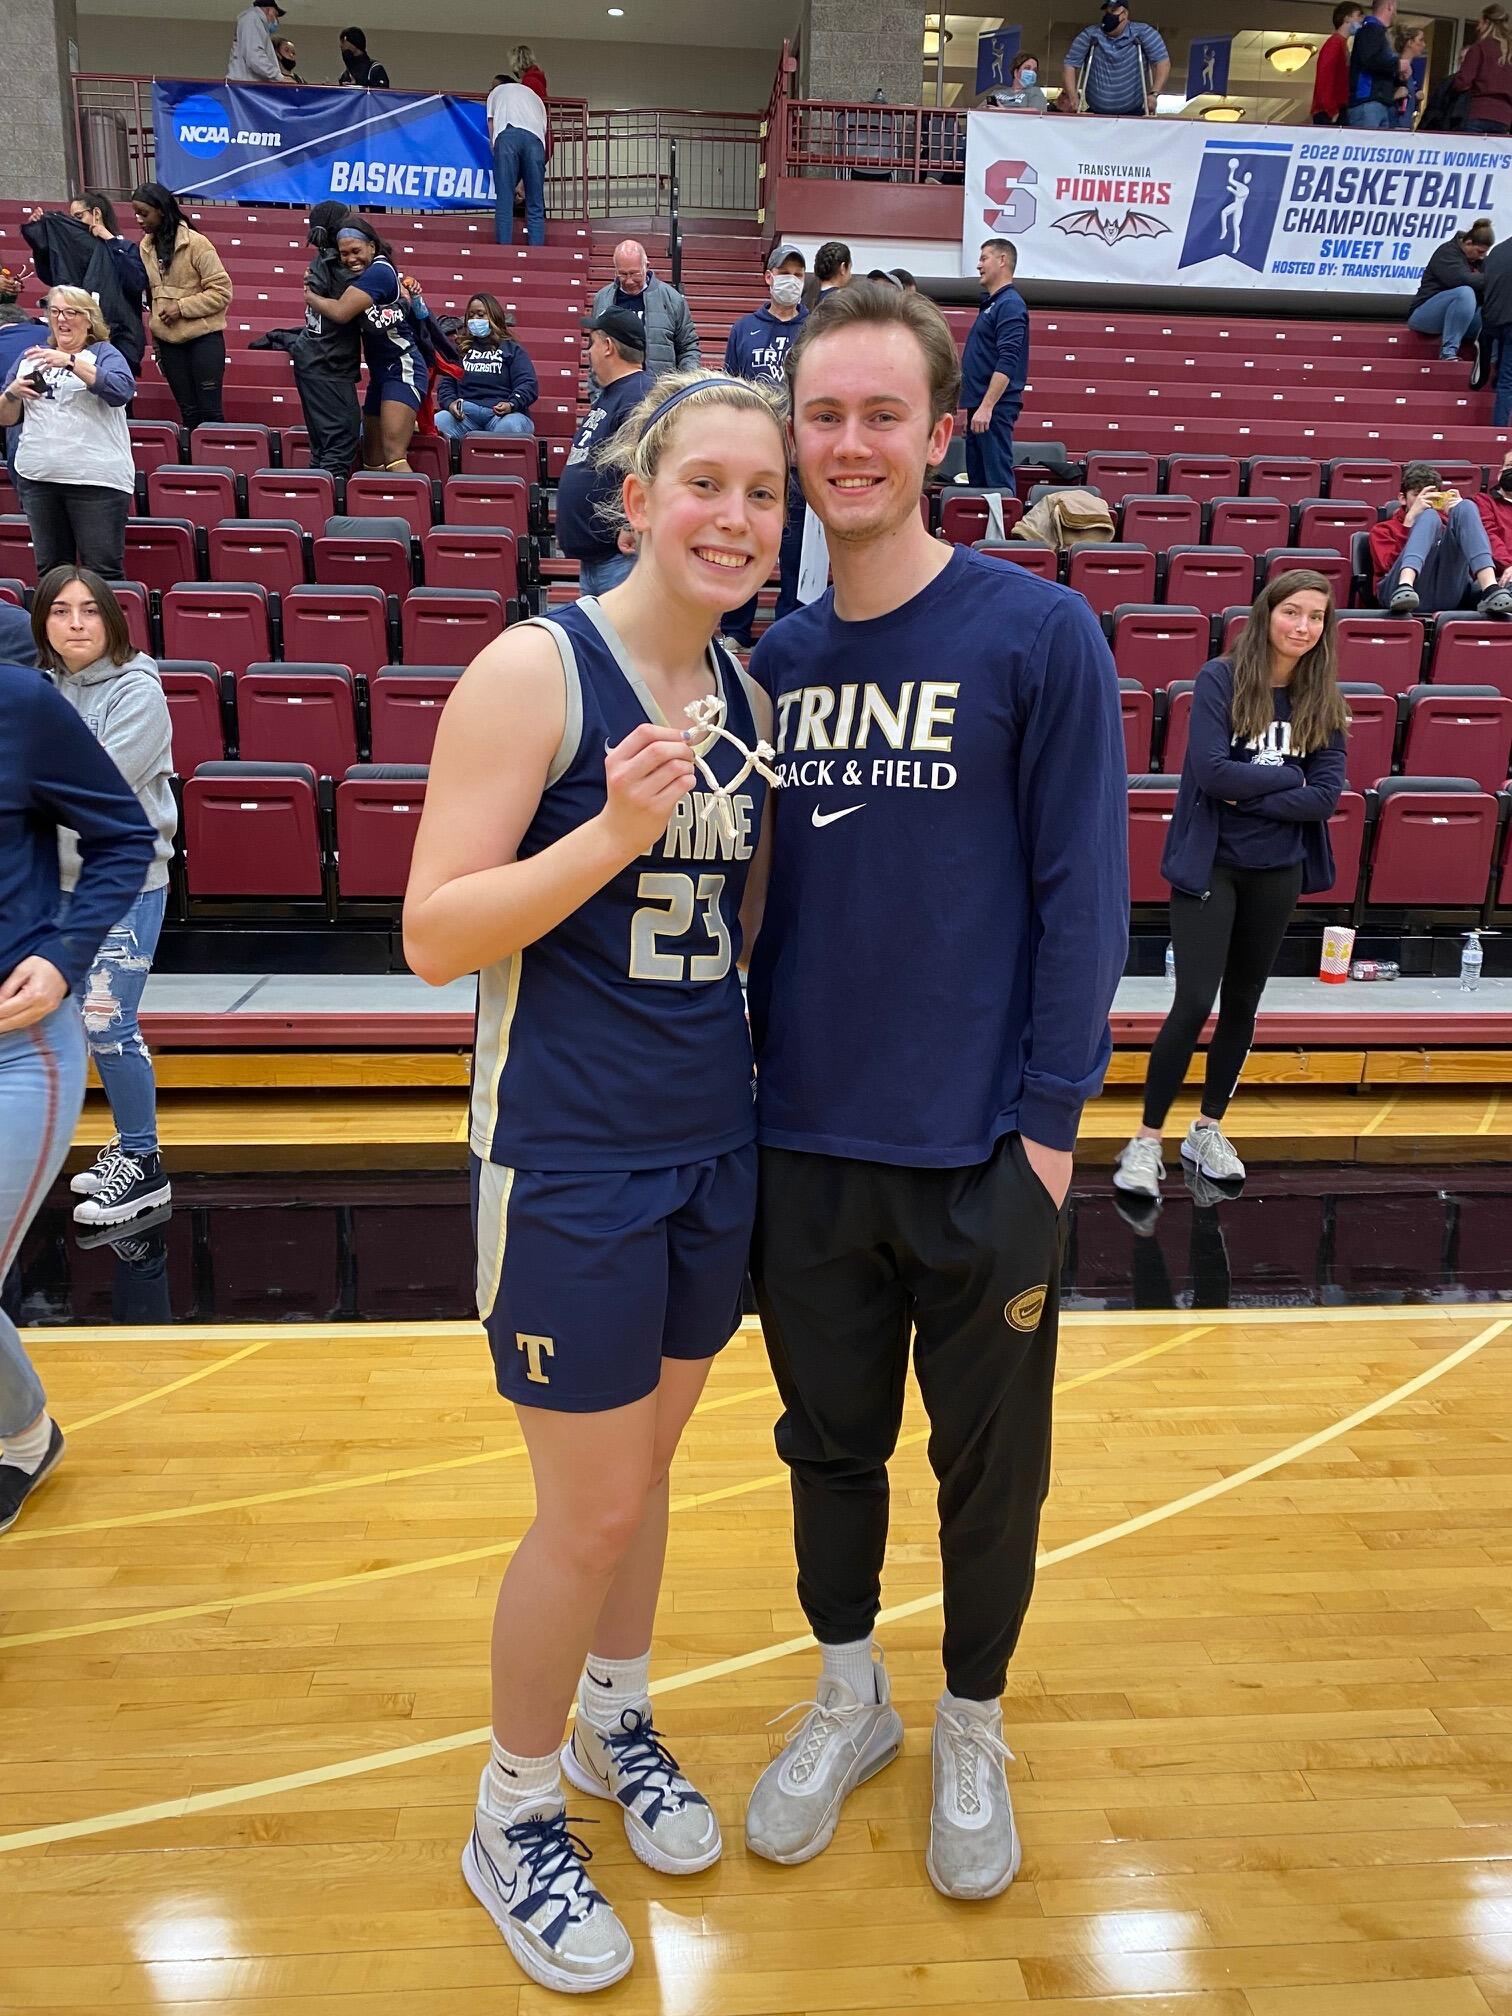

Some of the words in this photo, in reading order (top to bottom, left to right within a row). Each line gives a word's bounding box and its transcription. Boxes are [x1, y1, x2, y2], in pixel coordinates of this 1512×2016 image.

[179, 125, 281, 147] NCAA.com
[1078, 163, 1152, 178] TRANSYLVANIA
[1299, 143, 1339, 161] 2022
[1342, 145, 1415, 164] DIVISION
[1416, 149, 1441, 165] III
[1442, 151, 1512, 169] WOMEN'S
[330, 161, 498, 200] BASKETBALL
[1056, 177, 1172, 205] PIONEERS
[1289, 164, 1495, 211] BASKETBALL
[1282, 207, 1458, 239] CHAMPIONSHIP
[1319, 239, 1384, 260] SWEET
[1391, 242, 1412, 261] 16
[1271, 260, 1317, 275] HOSTED
[1318, 262, 1338, 276] BY:
[1342, 263, 1426, 280] TRANSYLVANIA
[777, 681, 961, 755] TRINE
[841, 759, 863, 786] &
[870, 759, 958, 790] FIELD
[640, 791, 754, 861] RINE
[628, 872, 732, 982] 23
[515, 1332, 555, 1384] T
